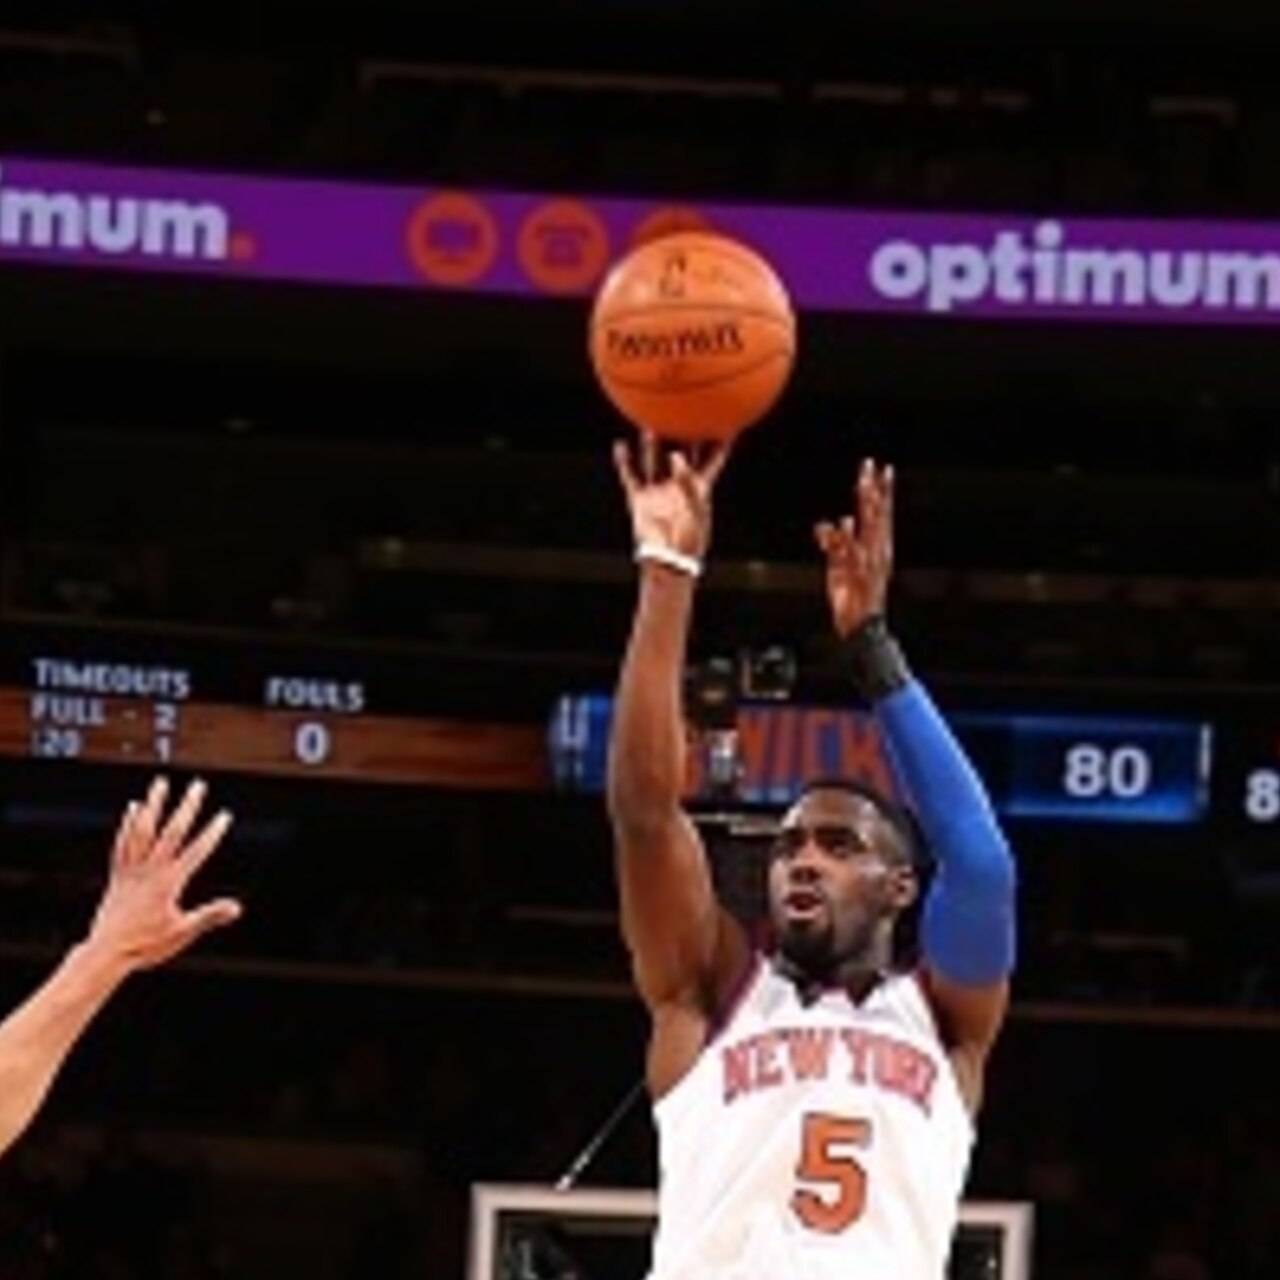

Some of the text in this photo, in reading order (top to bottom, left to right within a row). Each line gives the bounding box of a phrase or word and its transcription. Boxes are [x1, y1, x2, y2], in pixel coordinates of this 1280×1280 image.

[34, 659, 190, 697] TIMEOUTS
[266, 677, 364, 711] FOULS
[32, 696, 106, 724] FULL
[153, 704, 176, 732] 2
[156, 738, 172, 762] 1
[296, 722, 329, 763] 0
[1064, 745, 1149, 798] 80
[722, 1027, 834, 1105] NEW
[791, 1111, 873, 1236] 5
